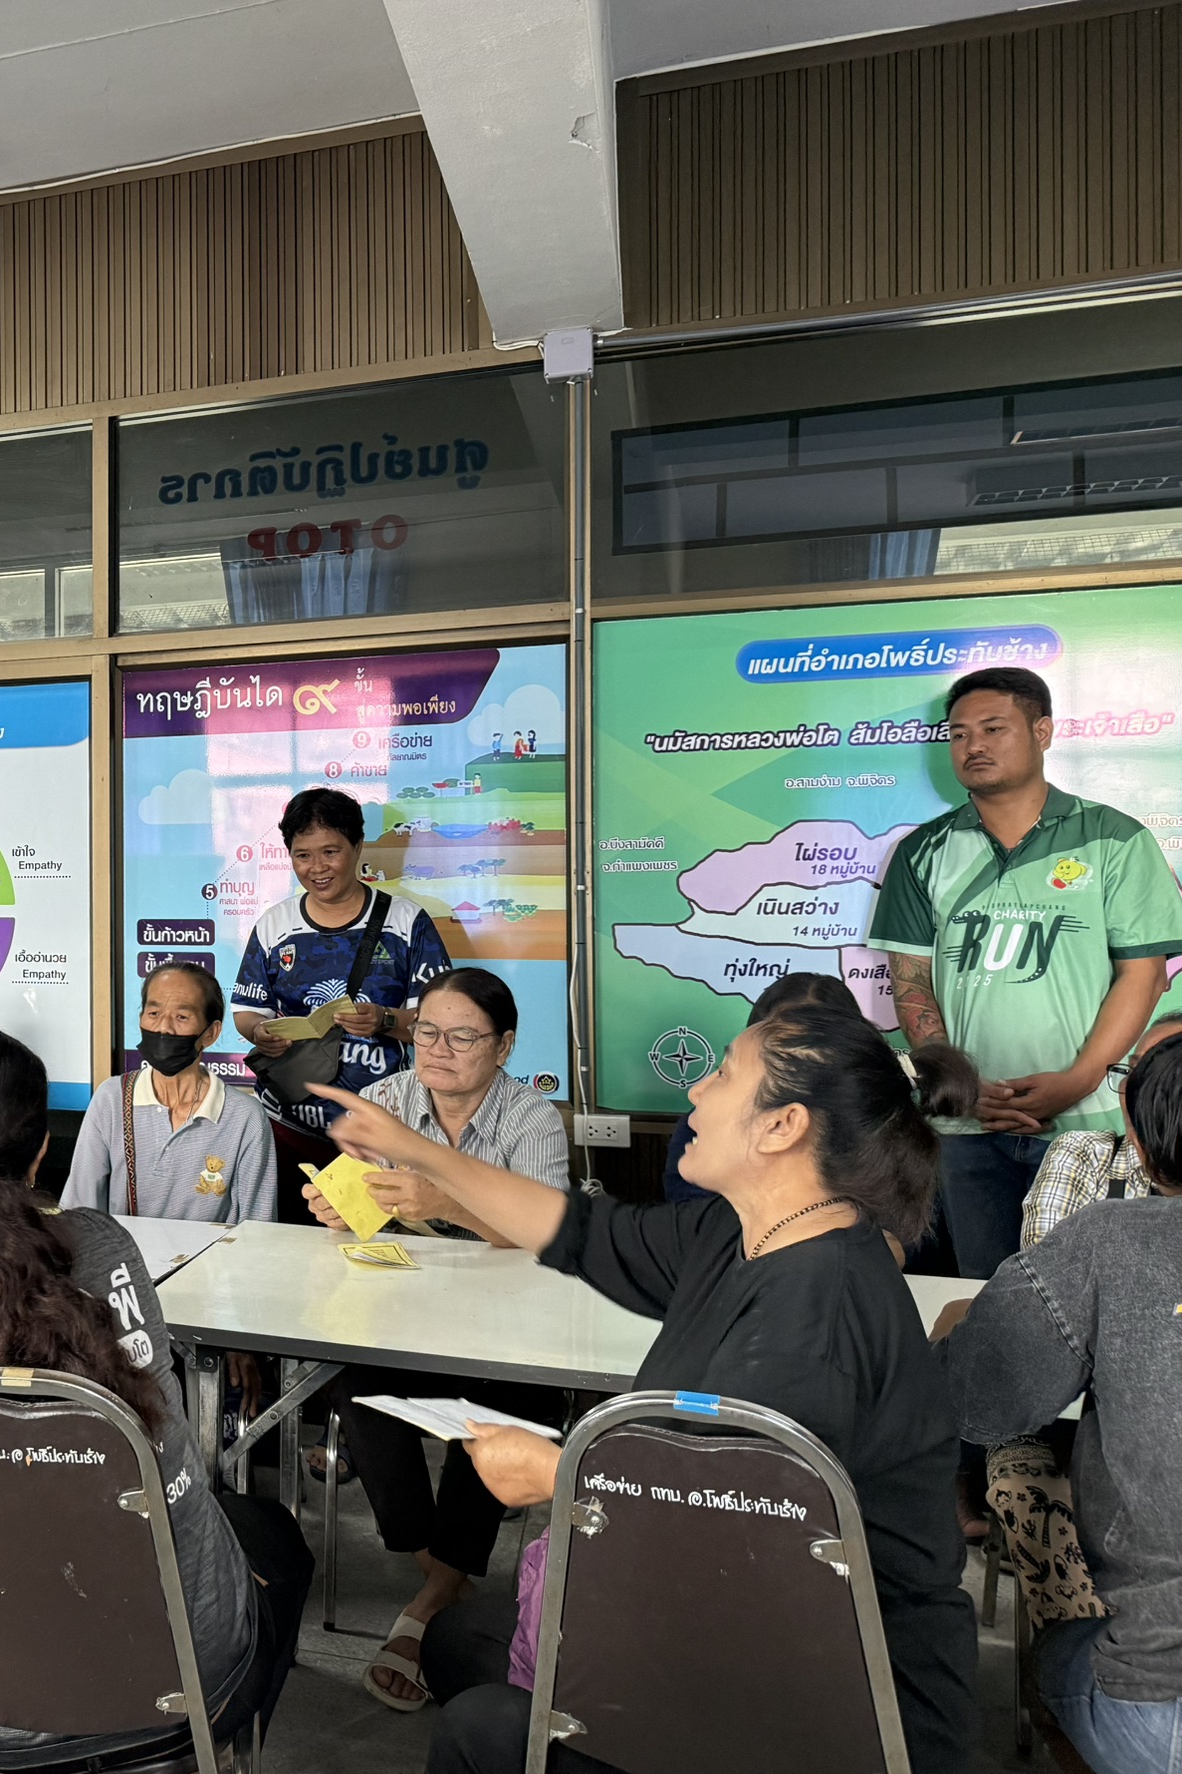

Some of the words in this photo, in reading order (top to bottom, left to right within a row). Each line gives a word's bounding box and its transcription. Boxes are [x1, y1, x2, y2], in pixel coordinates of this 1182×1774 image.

[748, 637, 1049, 676] แผนที่อำเภอโพธิ์ประทับช้าง
[354, 667, 372, 693] ขั้น
[136, 676, 283, 720] ทฤษฎีบันได
[357, 694, 456, 725] สู่ความพอเพียง
[379, 732, 433, 749] เครือข่าย
[350, 762, 387, 777] ค้าขาย
[785, 775, 841, 788] อ.สามง่าม
[847, 773, 896, 787] จ.พิจิตร
[12, 845, 36, 858] เข้าใจ
[260, 842, 290, 859] ให้ทา
[795, 842, 857, 861] ไผ่รอบ
[19, 860, 63, 873] Empathy
[601, 860, 678, 872] จ.กำแพงเพชร
[811, 863, 826, 875] 18
[830, 862, 876, 878] หมู่บ้าน
[220, 878, 254, 897] ทำบุญ
[757, 896, 839, 916] เนินสว่าง
[994, 909, 1047, 921] CHARITY
[143, 924, 210, 943] ขั้นก้าวหน้า
[793, 926, 808, 936] 14
[812, 924, 857, 940] หมู่บ้าน
[953, 911, 1066, 980] RUN
[15, 951, 67, 964] เอื้ออำนวย
[23, 969, 67, 981] Empathy
[723, 958, 791, 982] ทุ่งใหญ่
[878, 985, 893, 995] 15
[957, 974, 993, 989] 225
[234, 982, 268, 1001] anulife
[679, 1027, 686, 1035] N
[649, 1053, 659, 1061] W
[166, 1467, 191, 1504] 30%
[584, 1473, 642, 1496] เครือข่าย
[650, 1486, 684, 1503] กทบ.
